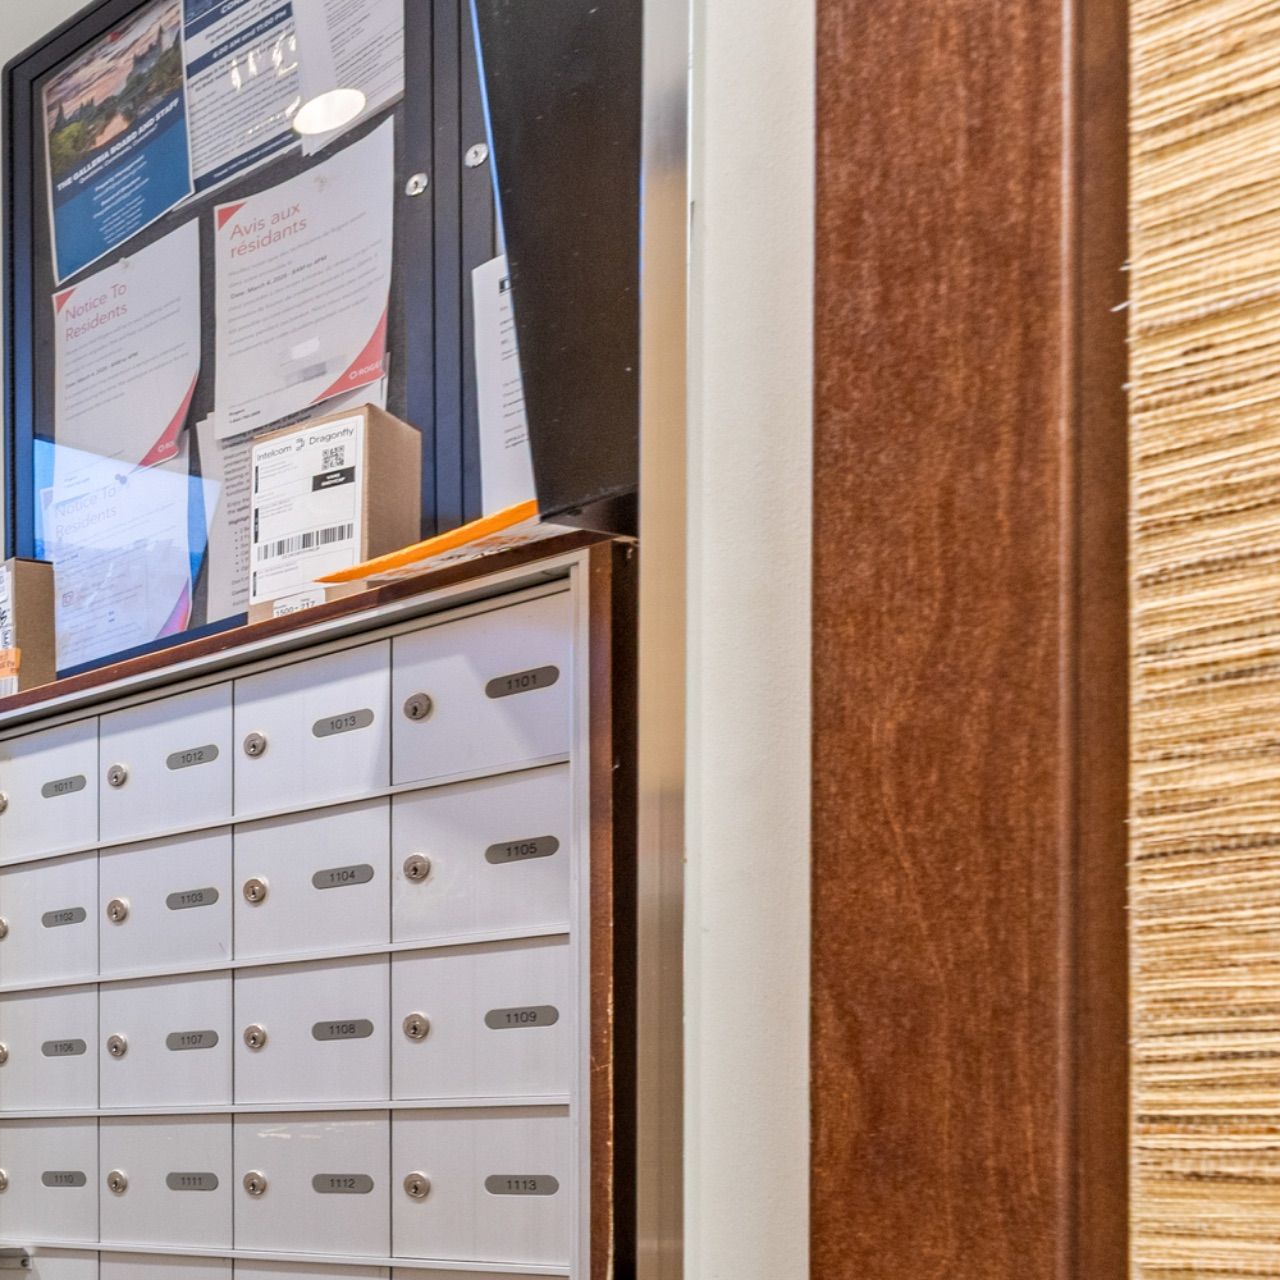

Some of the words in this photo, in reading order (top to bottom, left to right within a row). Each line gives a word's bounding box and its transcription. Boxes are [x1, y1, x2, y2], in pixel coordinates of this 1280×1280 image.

[73, 150, 109, 186] GALLERIA
[110, 130, 137, 156] BOARD
[229, 220, 266, 241] Avis
[271, 202, 301, 226] aux
[230, 218, 307, 258] résidants
[65, 294, 108, 322] Notice
[110, 282, 128, 299] To
[65, 303, 128, 342] Residents
[309, 427, 354, 446] Dragonfly
[505, 675, 536, 689] 1101
[330, 716, 356, 730] 1013
[181, 751, 203, 764] 1012
[54, 781, 73, 792] 1011
[507, 843, 537, 856] 1105
[330, 871, 355, 883] 1104
[181, 892, 203, 902] 1103
[55, 912, 73, 921] 1102
[506, 1011, 537, 1023] 1109
[330, 1024, 355, 1034] 1108
[181, 1034, 203, 1044] 1107
[55, 1043, 73, 1052] 1106
[55, 1175, 73, 1183] 1110
[182, 1177, 202, 1185] 1111
[330, 1178, 355, 1188] 1112
[507, 1180, 536, 1190] 1113
